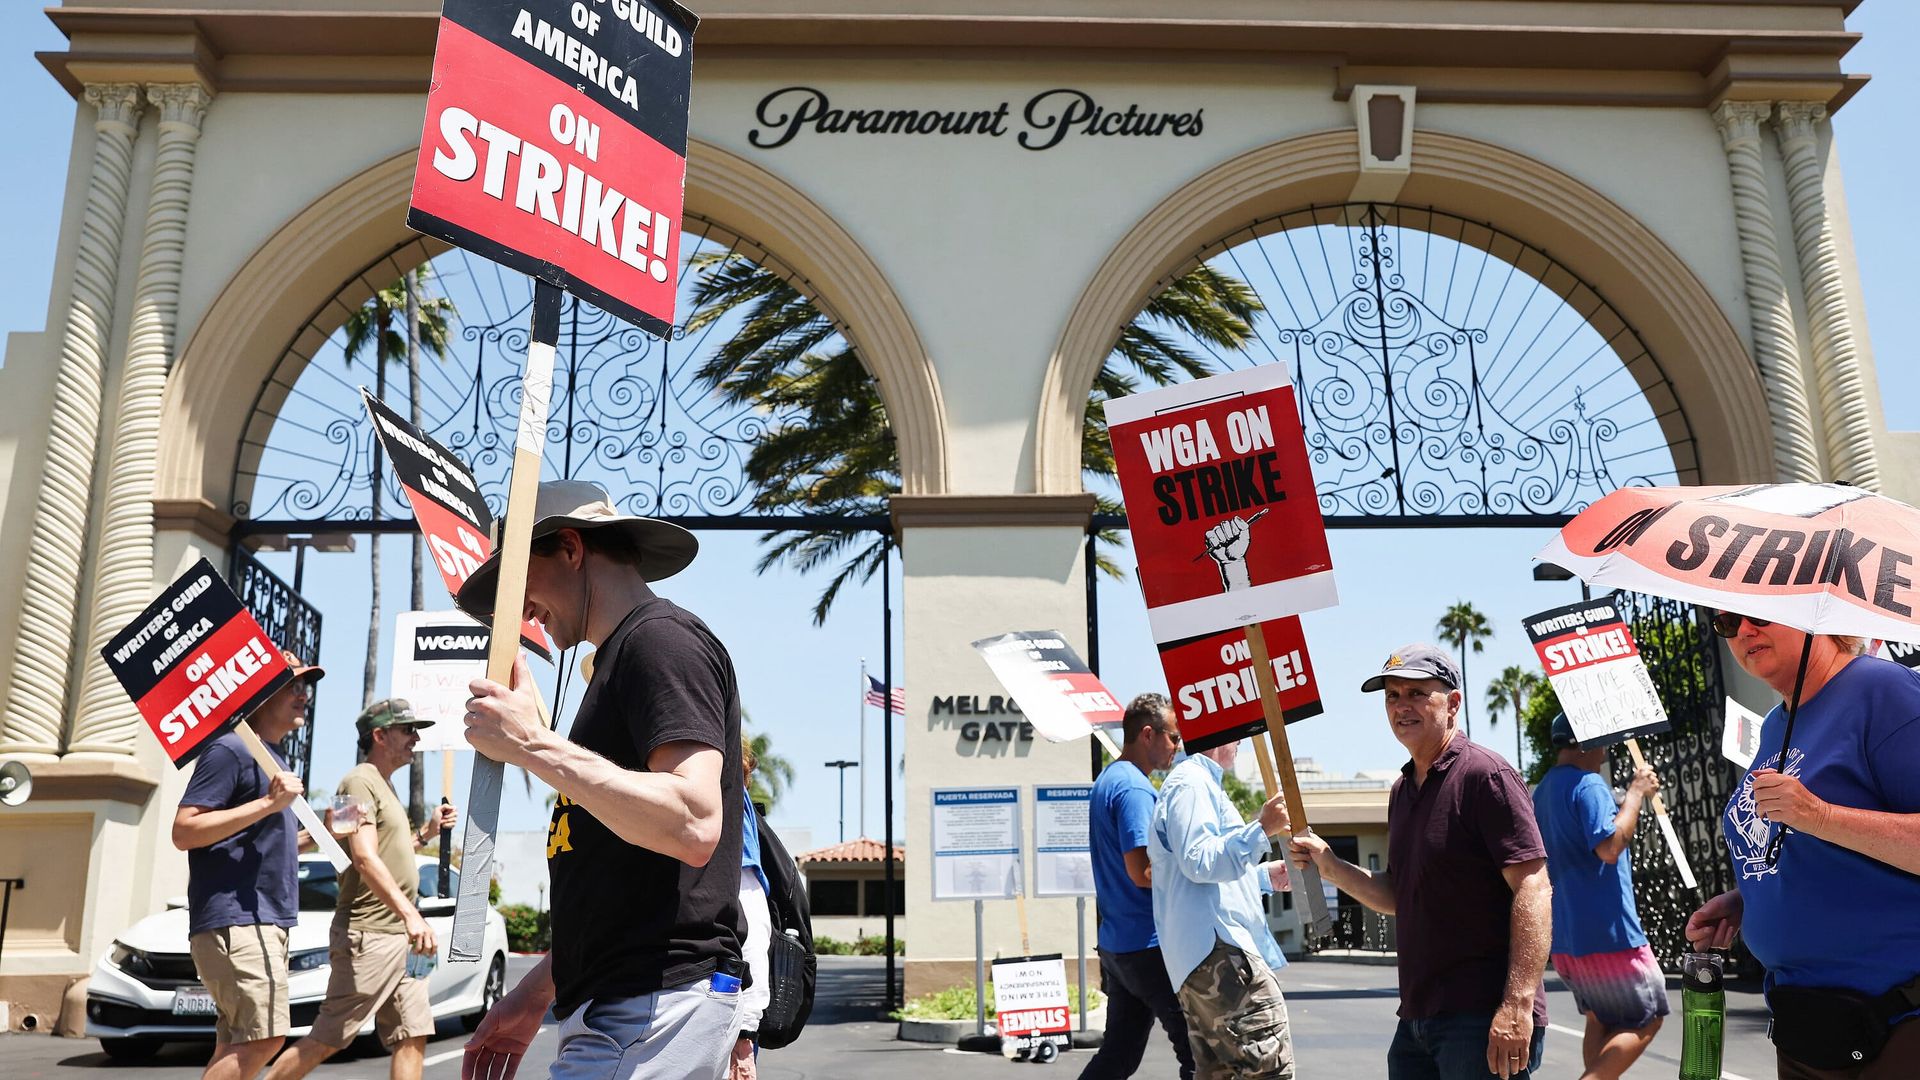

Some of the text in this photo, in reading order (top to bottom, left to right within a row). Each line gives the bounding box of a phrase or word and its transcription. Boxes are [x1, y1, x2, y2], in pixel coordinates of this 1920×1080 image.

[571, 1, 601, 37] OF
[611, 0, 683, 57] GUILD
[511, 8, 639, 110] AMERICA
[549, 103, 600, 162] ON
[748, 86, 1204, 151] Paramount Pictures
[432, 106, 671, 282] STRIKE!
[1139, 405, 1275, 474] WGA ON
[439, 455, 476, 492] GUILD
[1153, 451, 1287, 526] STRIKE
[420, 474, 481, 527] AMERICA
[457, 526, 485, 559] ON
[1593, 500, 1913, 618] ON STRIKE
[112, 574, 212, 664] WRITERS GUILD
[163, 622, 179, 640] OF
[1531, 605, 1615, 636] WRITERS GUILD
[151, 617, 214, 675] AMERICA
[416, 635, 489, 650] WGAW
[1220, 639, 1251, 665] ON
[1544, 628, 1632, 671] STRIKE!
[185, 652, 215, 682] ON
[159, 636, 272, 745] STRIKE!
[933, 695, 1024, 715] MELRO
[961, 721, 1034, 742] GATE
[937, 791, 1015, 802] PUERTA RESERVADA
[1047, 789, 1088, 798] RESERVED
[1001, 1008, 1067, 1033] STRIKE!
